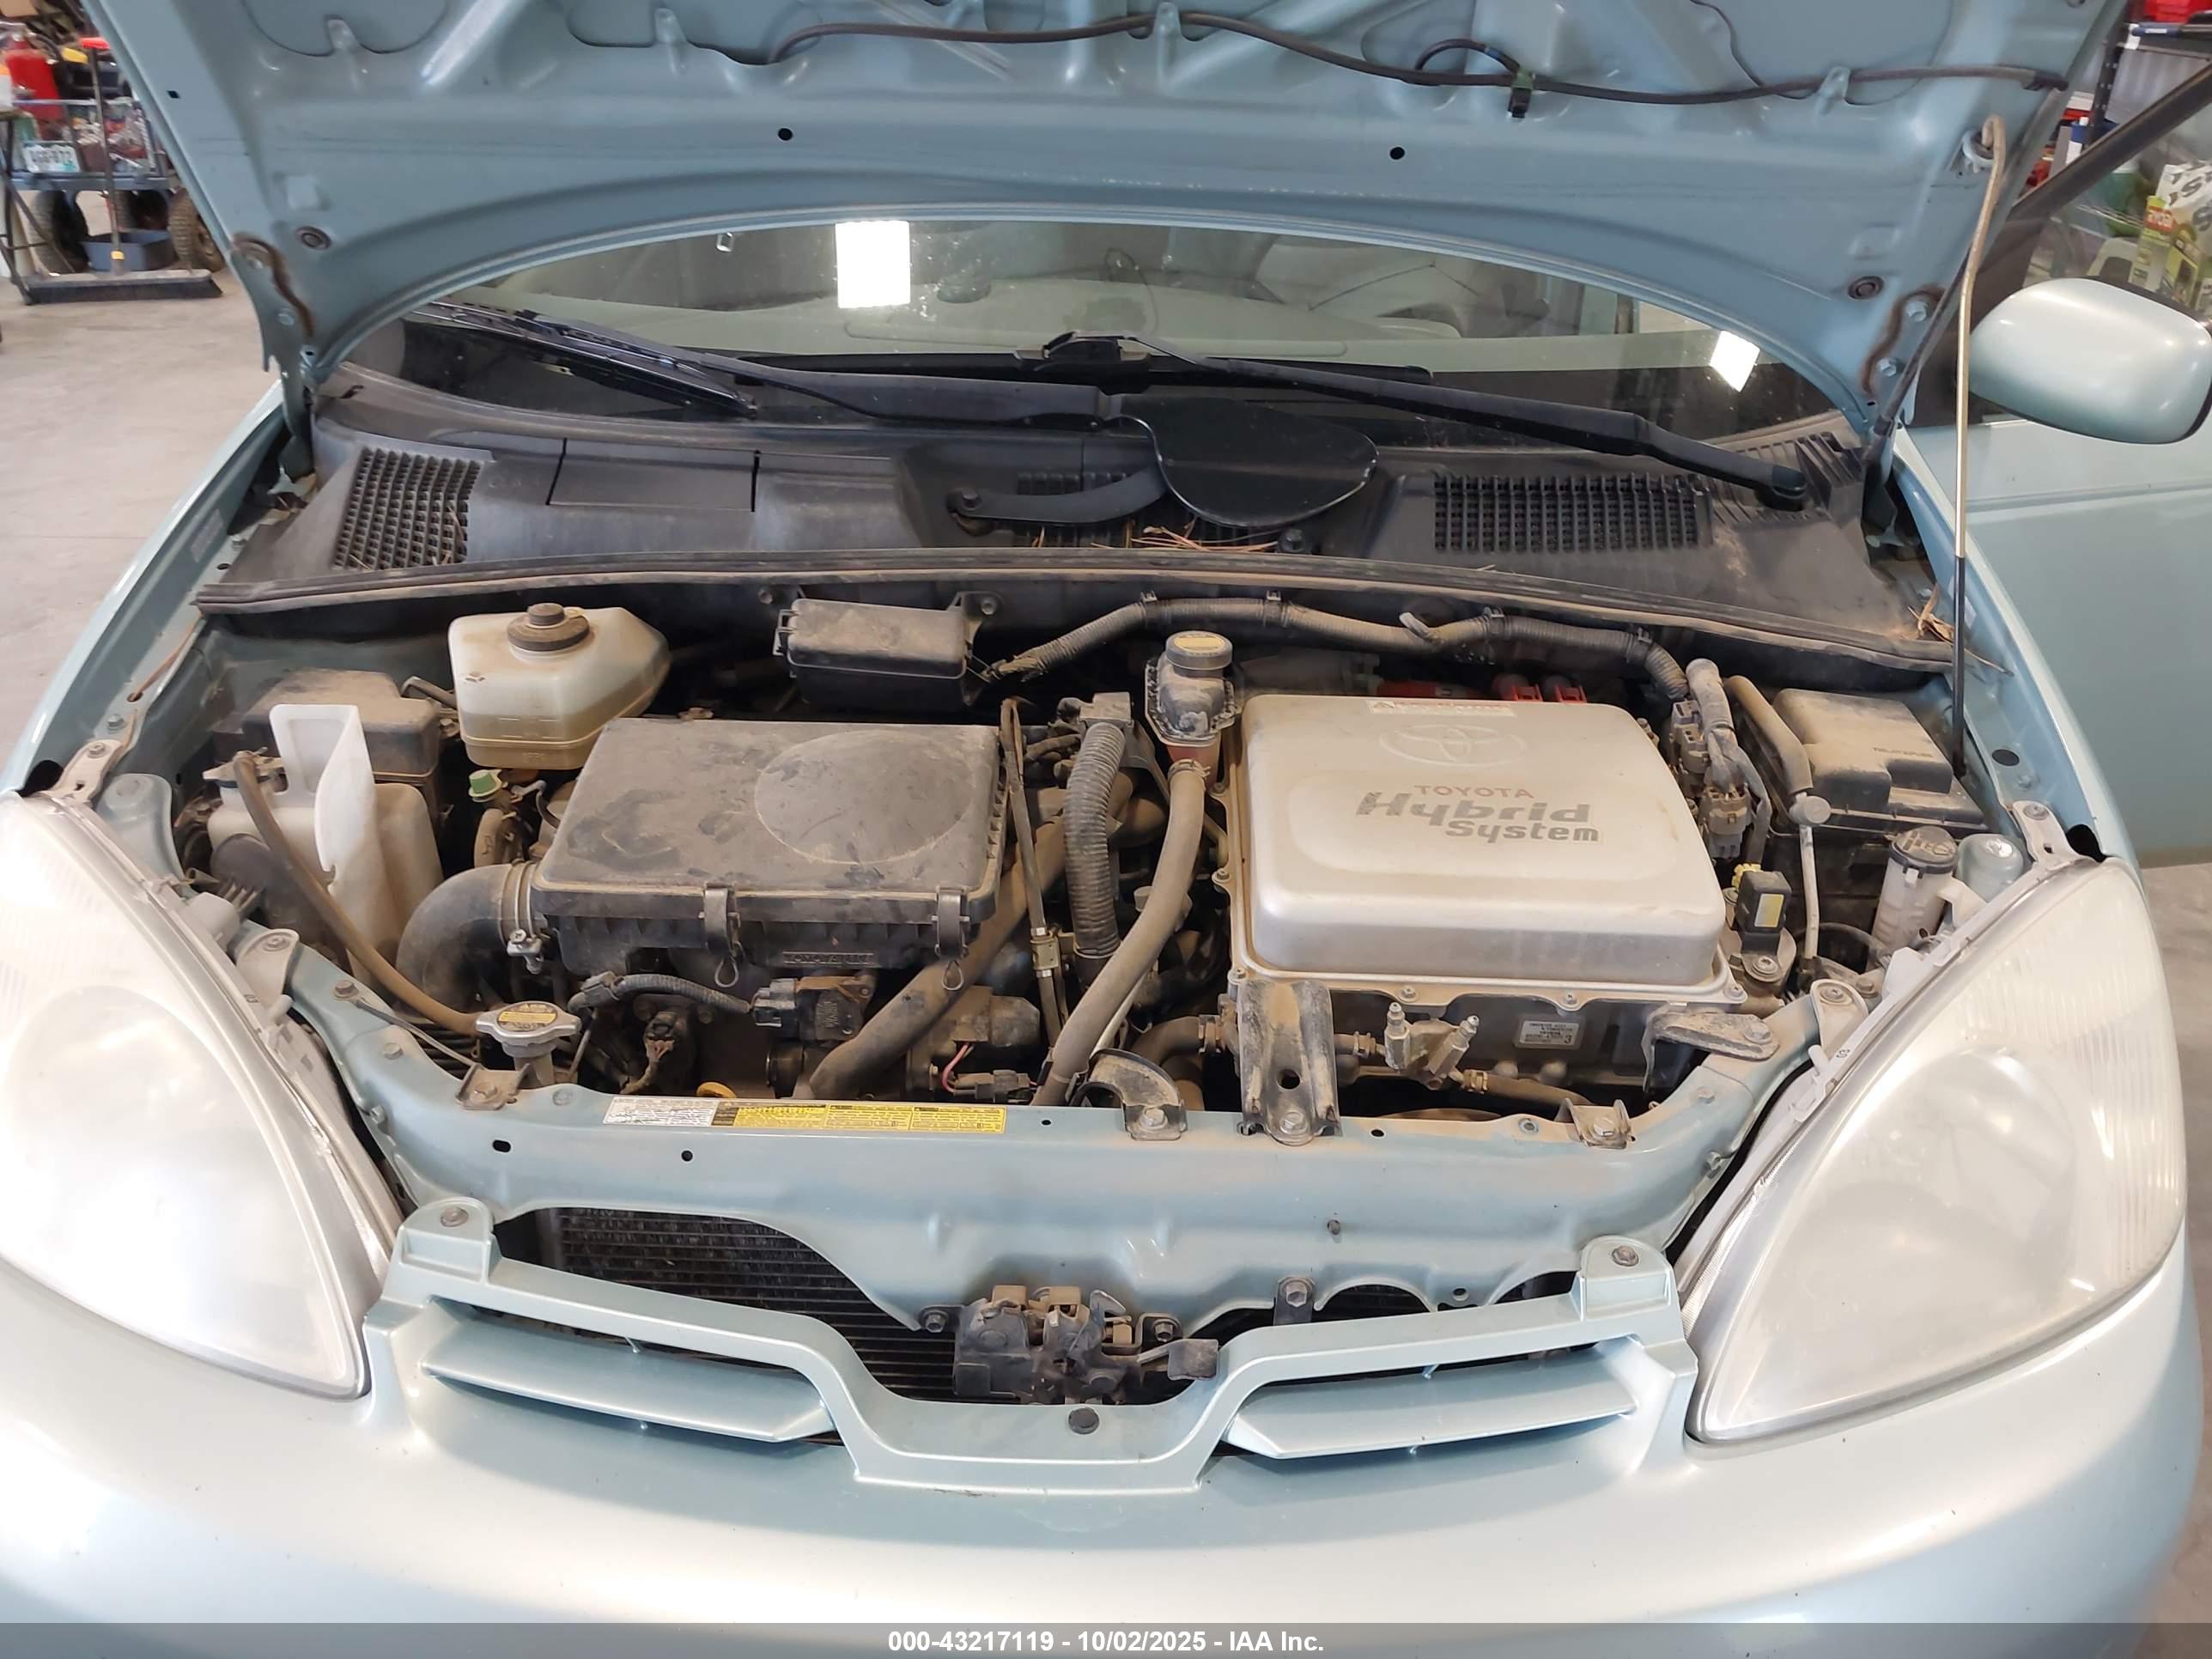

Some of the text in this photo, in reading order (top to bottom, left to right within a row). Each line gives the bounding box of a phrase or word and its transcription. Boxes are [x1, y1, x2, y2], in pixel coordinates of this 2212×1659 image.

[1414, 785, 1535, 799] TOYOTA
[1355, 792, 1591, 826] Hybrid
[1445, 820, 1599, 843] System
